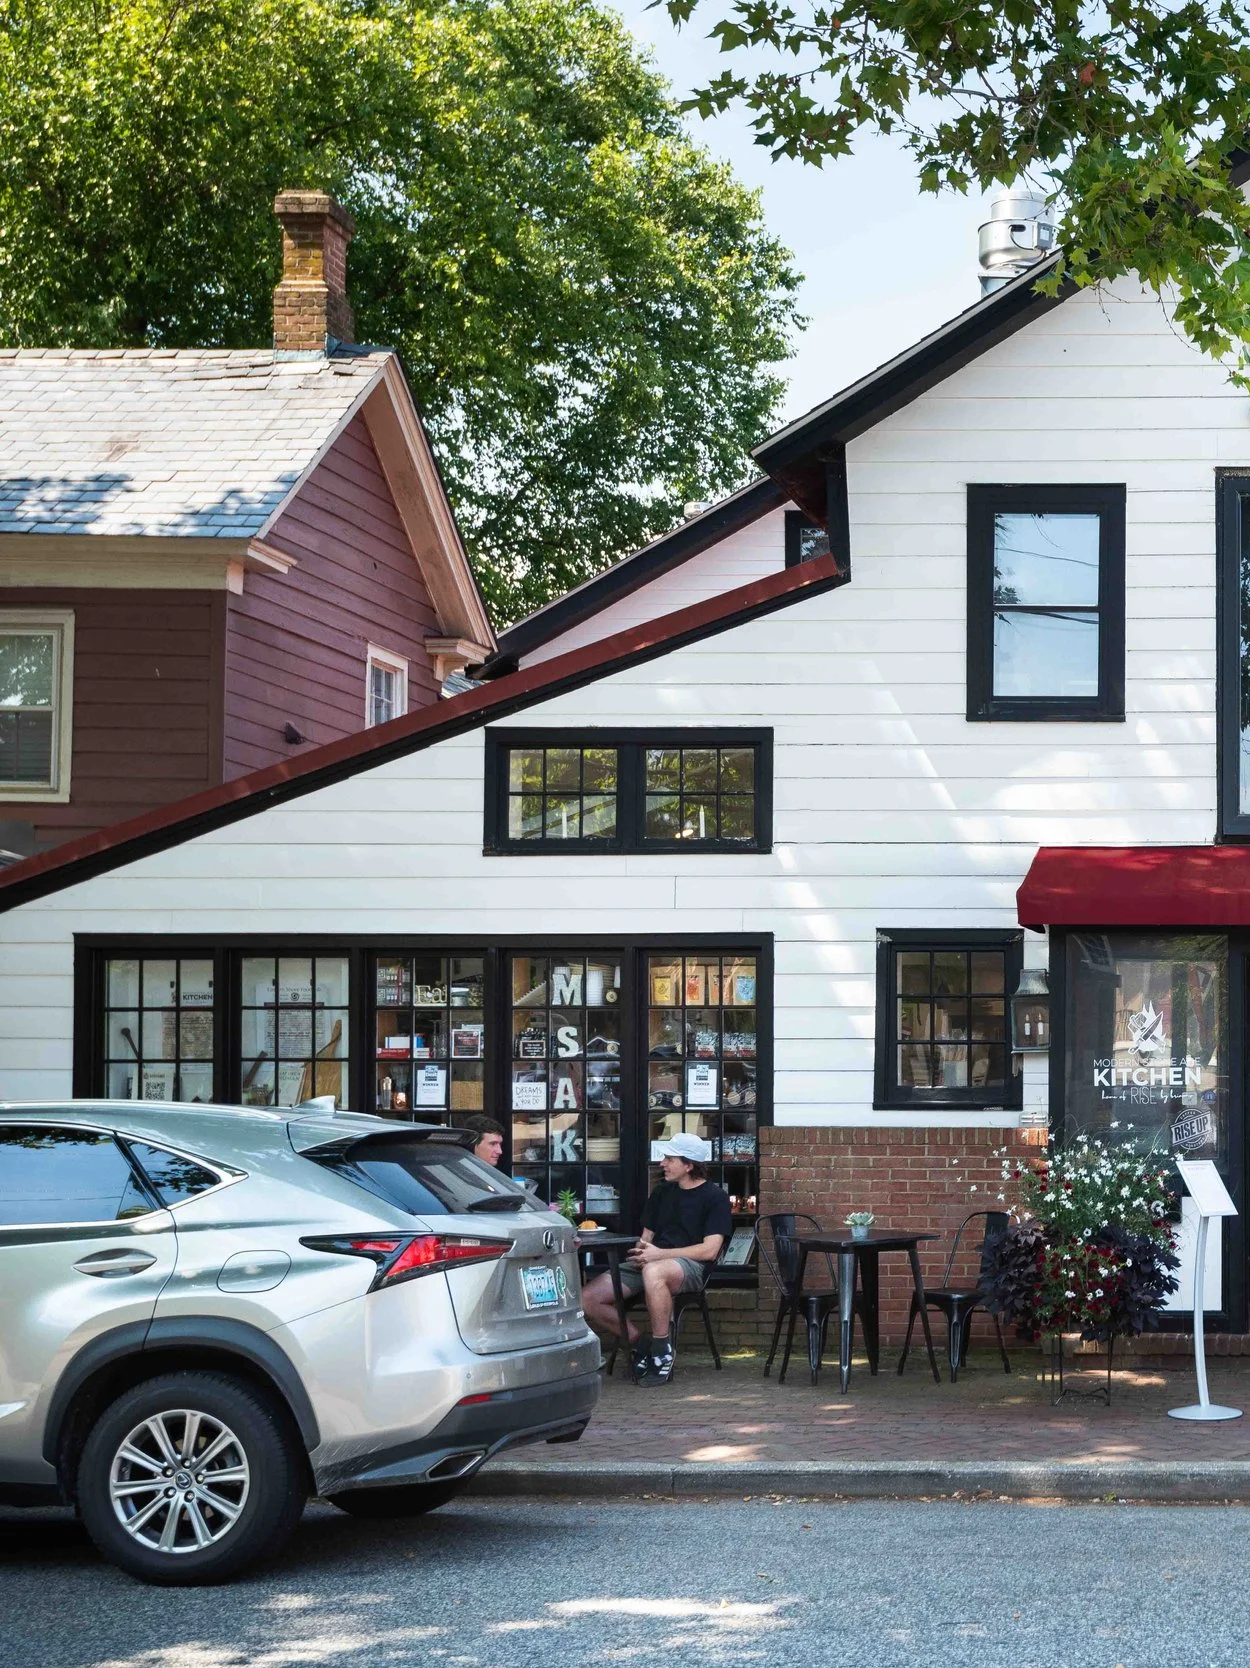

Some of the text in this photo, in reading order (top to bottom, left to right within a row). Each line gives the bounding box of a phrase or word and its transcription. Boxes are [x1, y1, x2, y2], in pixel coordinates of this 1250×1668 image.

[1093, 1059, 1139, 1068] MODERN
[1179, 1057, 1202, 1067] AE
[1093, 1067, 1202, 1087] KITCHEN
[1130, 1086, 1157, 1105] RISE
[1173, 1116, 1209, 1142] RISE UP
